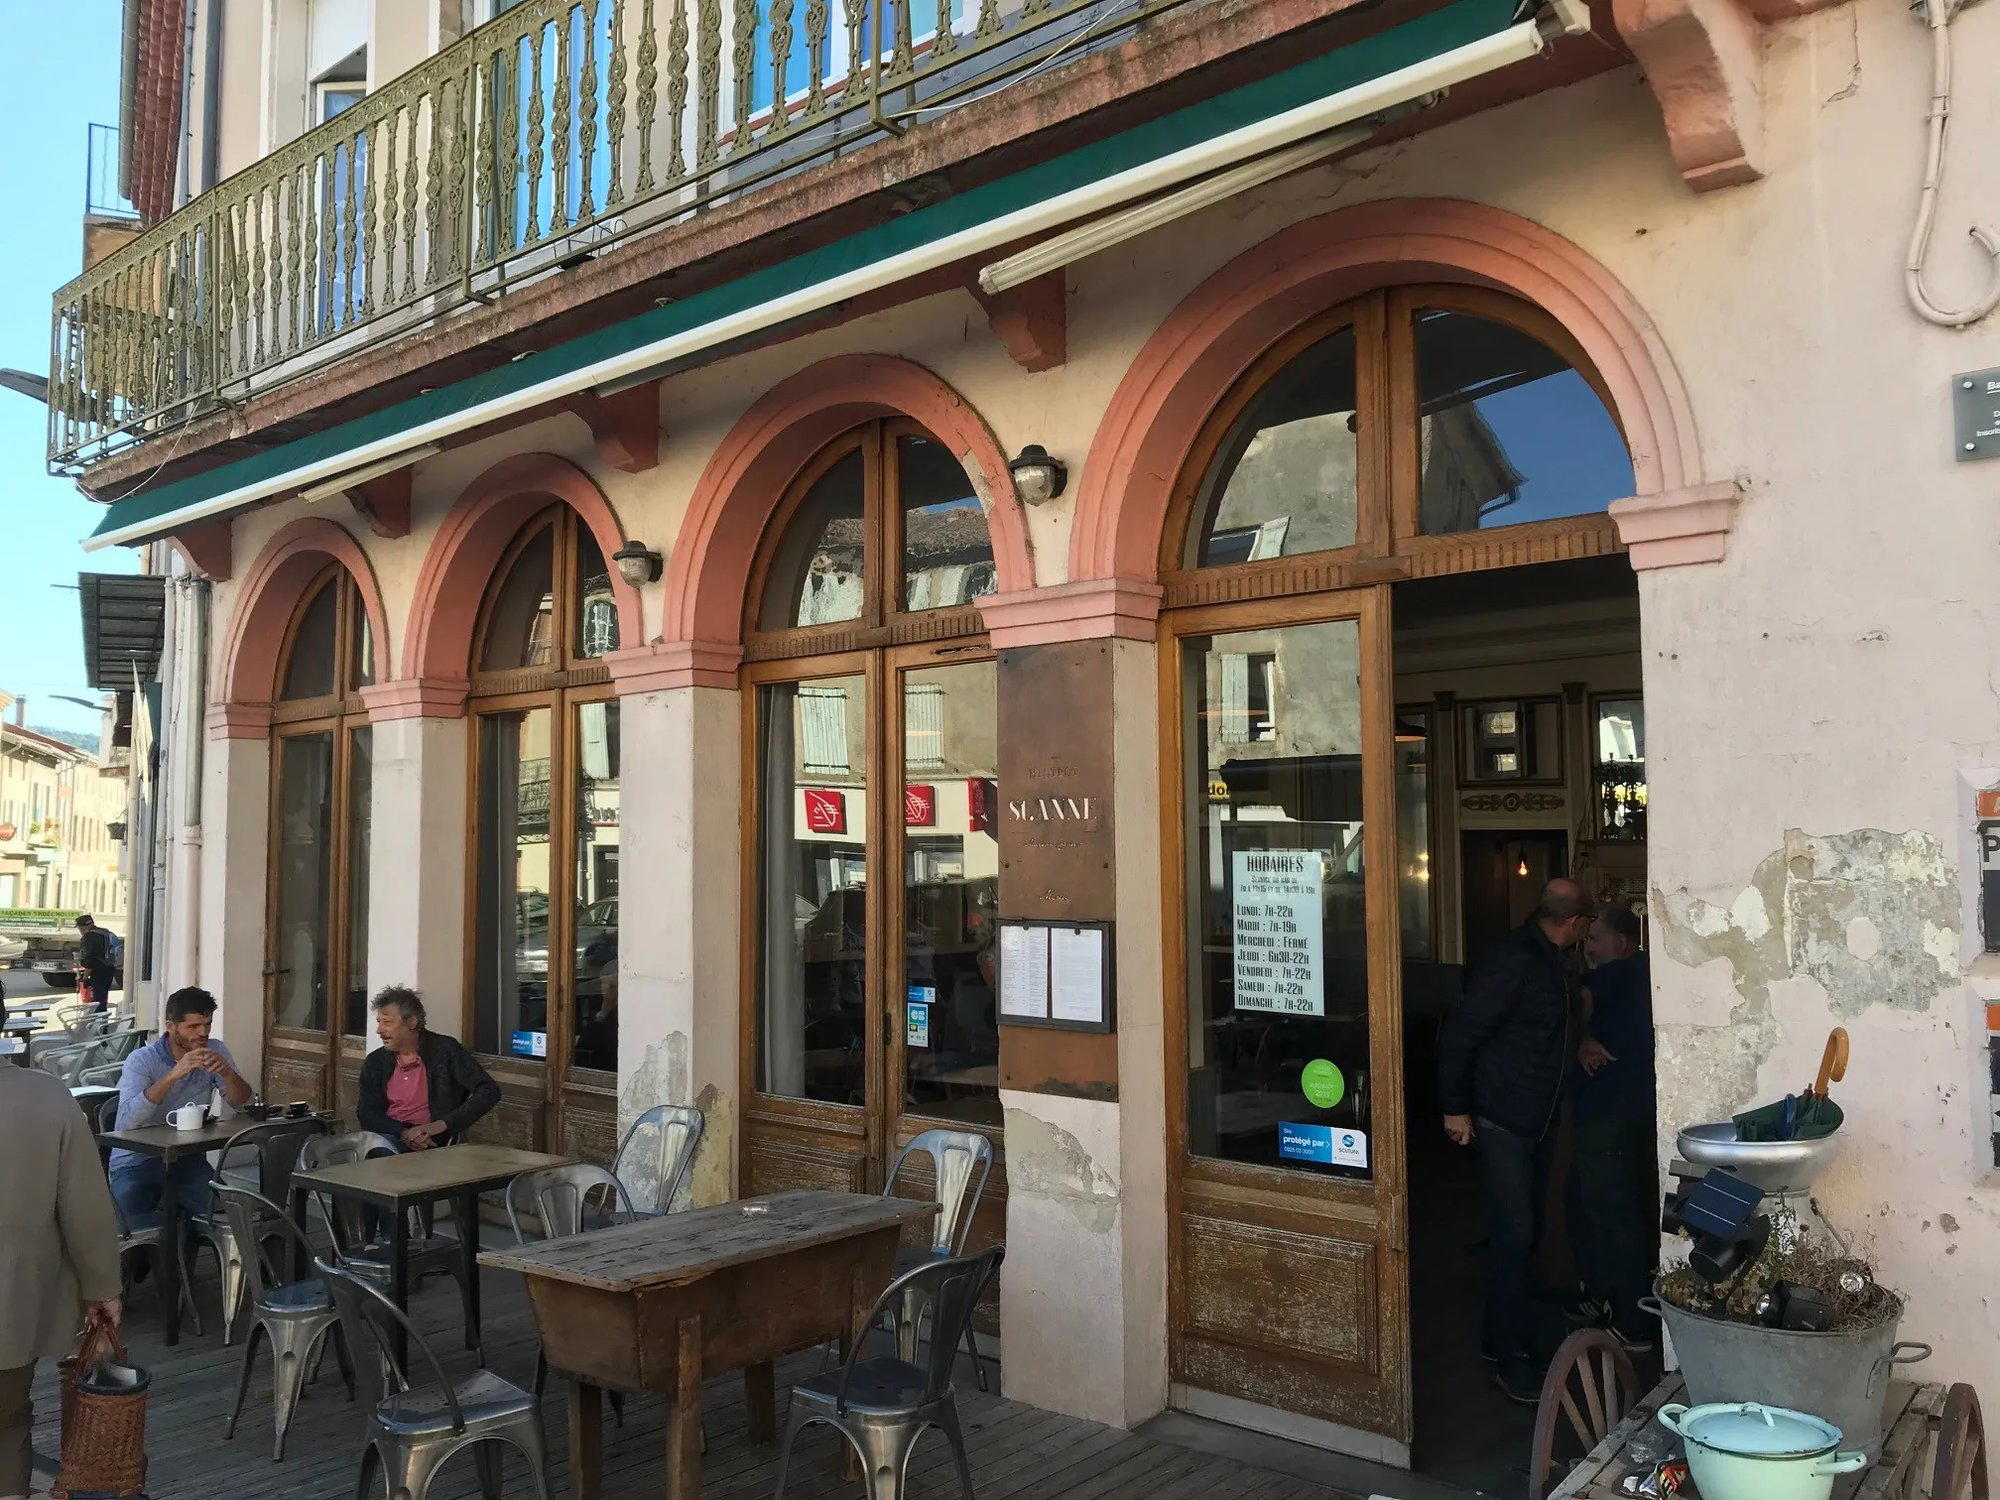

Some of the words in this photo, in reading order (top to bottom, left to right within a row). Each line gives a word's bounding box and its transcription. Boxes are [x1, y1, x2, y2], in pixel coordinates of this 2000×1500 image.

[1247, 855, 1304, 873] HORAIRES
[1238, 919, 1260, 931] MARDI
[1238, 934, 1274, 947] MERCREDI
[1238, 949, 1259, 961] JEUDI
[1238, 964, 1272, 977] VENDREDI
[1238, 979, 1264, 992] SAMEDI
[1239, 994, 1274, 1008] DIMANCHE
[1283, 1136, 1311, 1146] protégé
